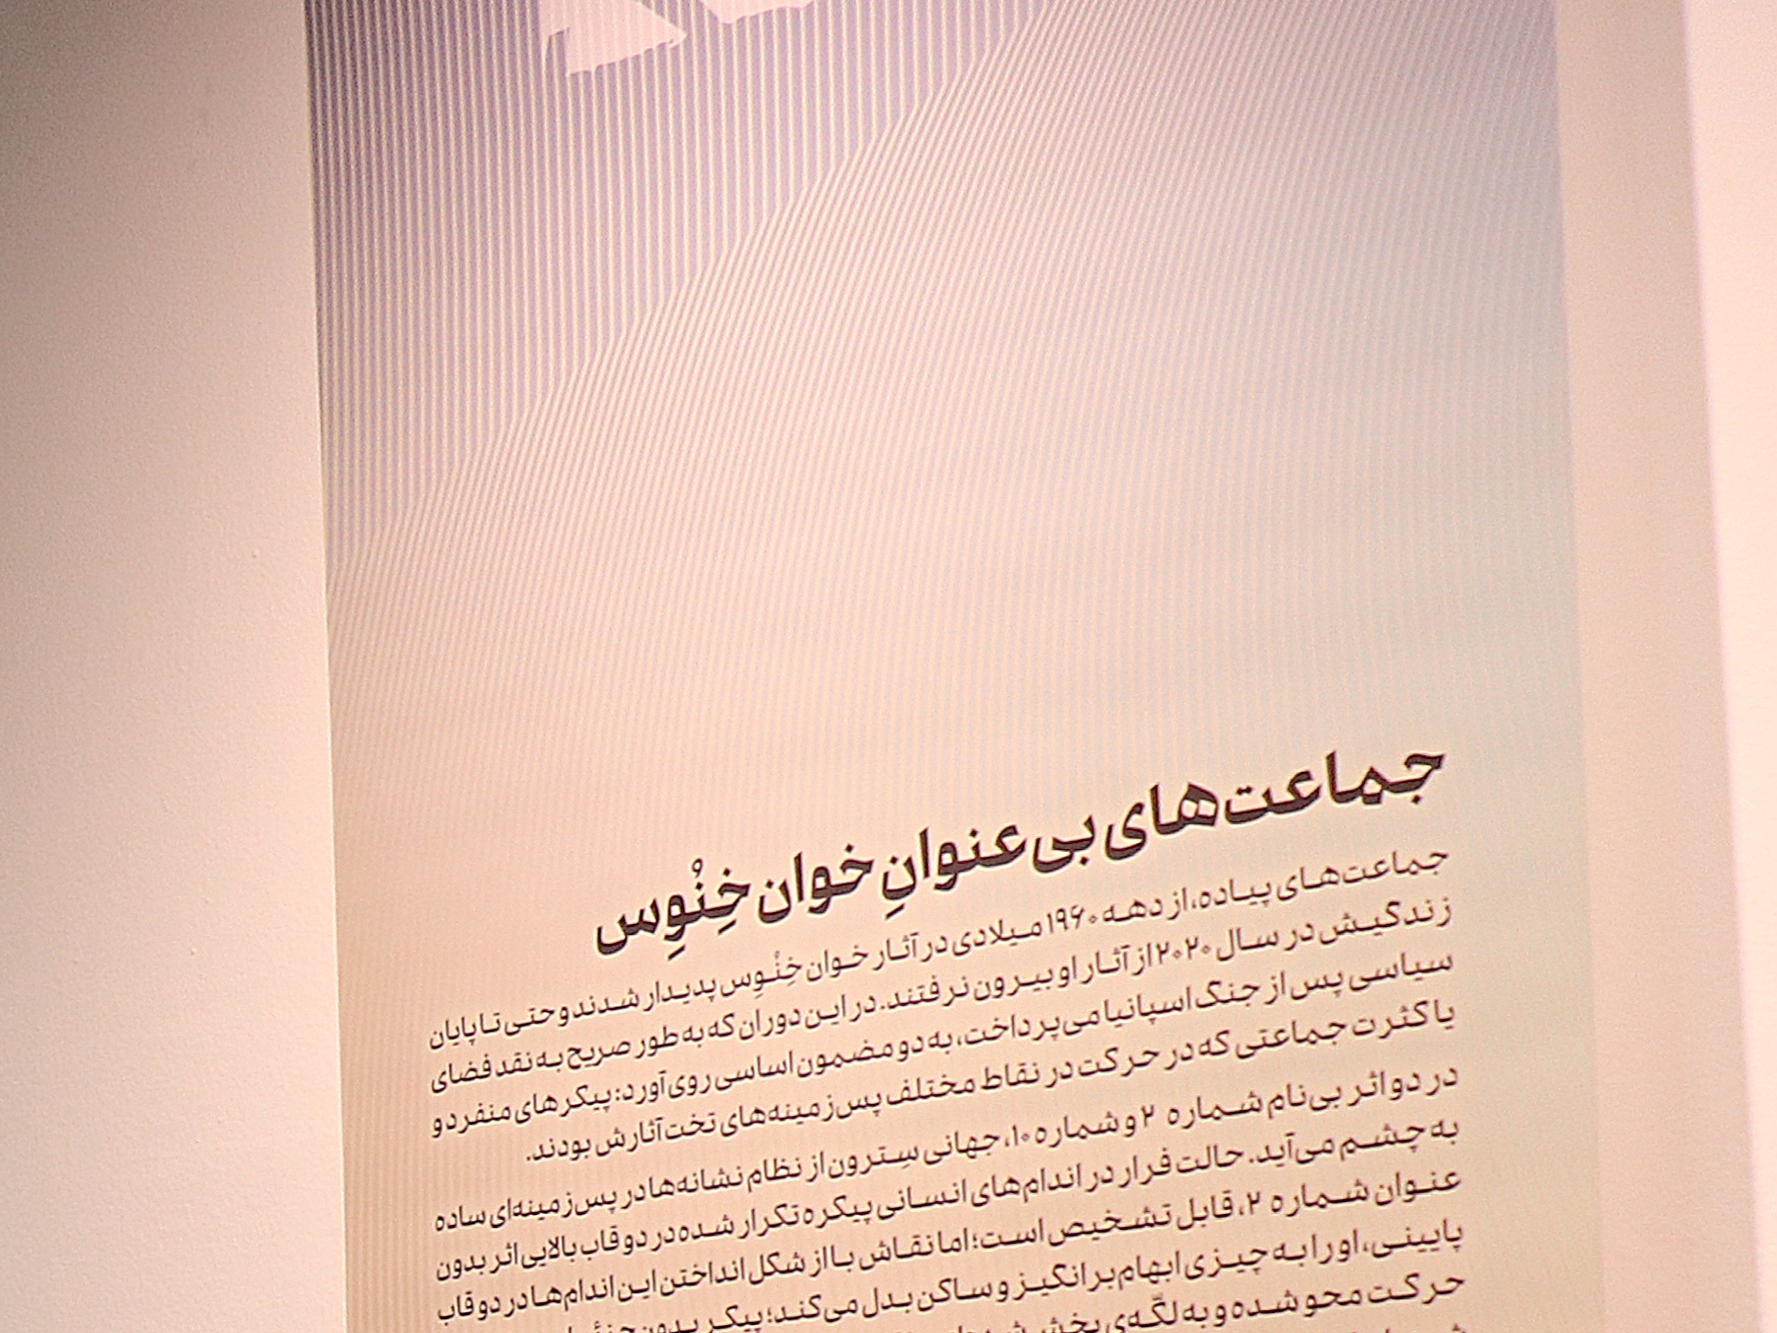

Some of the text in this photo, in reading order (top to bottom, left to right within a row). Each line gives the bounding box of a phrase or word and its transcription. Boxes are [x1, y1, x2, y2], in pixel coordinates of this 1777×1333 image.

[1104, 749, 1445, 861] جماعت‌های
[758, 842, 875, 924] خوان
[1276, 850, 1449, 902] جماعت‌های
[1103, 897, 1163, 923] دهه
[1166, 886, 1188, 921] از
[872, 931, 917, 971] آثار
[920, 934, 948, 962] در
[952, 918, 1043, 957] میلادی
[806, 944, 869, 982] خوان
[572, 986, 640, 1019] شدند
[642, 978, 717, 1012] پدیدار
[429, 1015, 477, 1050] پایان
[479, 1011, 501, 1034] تا
[504, 1006, 556, 1037] حتی
[558, 1005, 569, 1027] و
